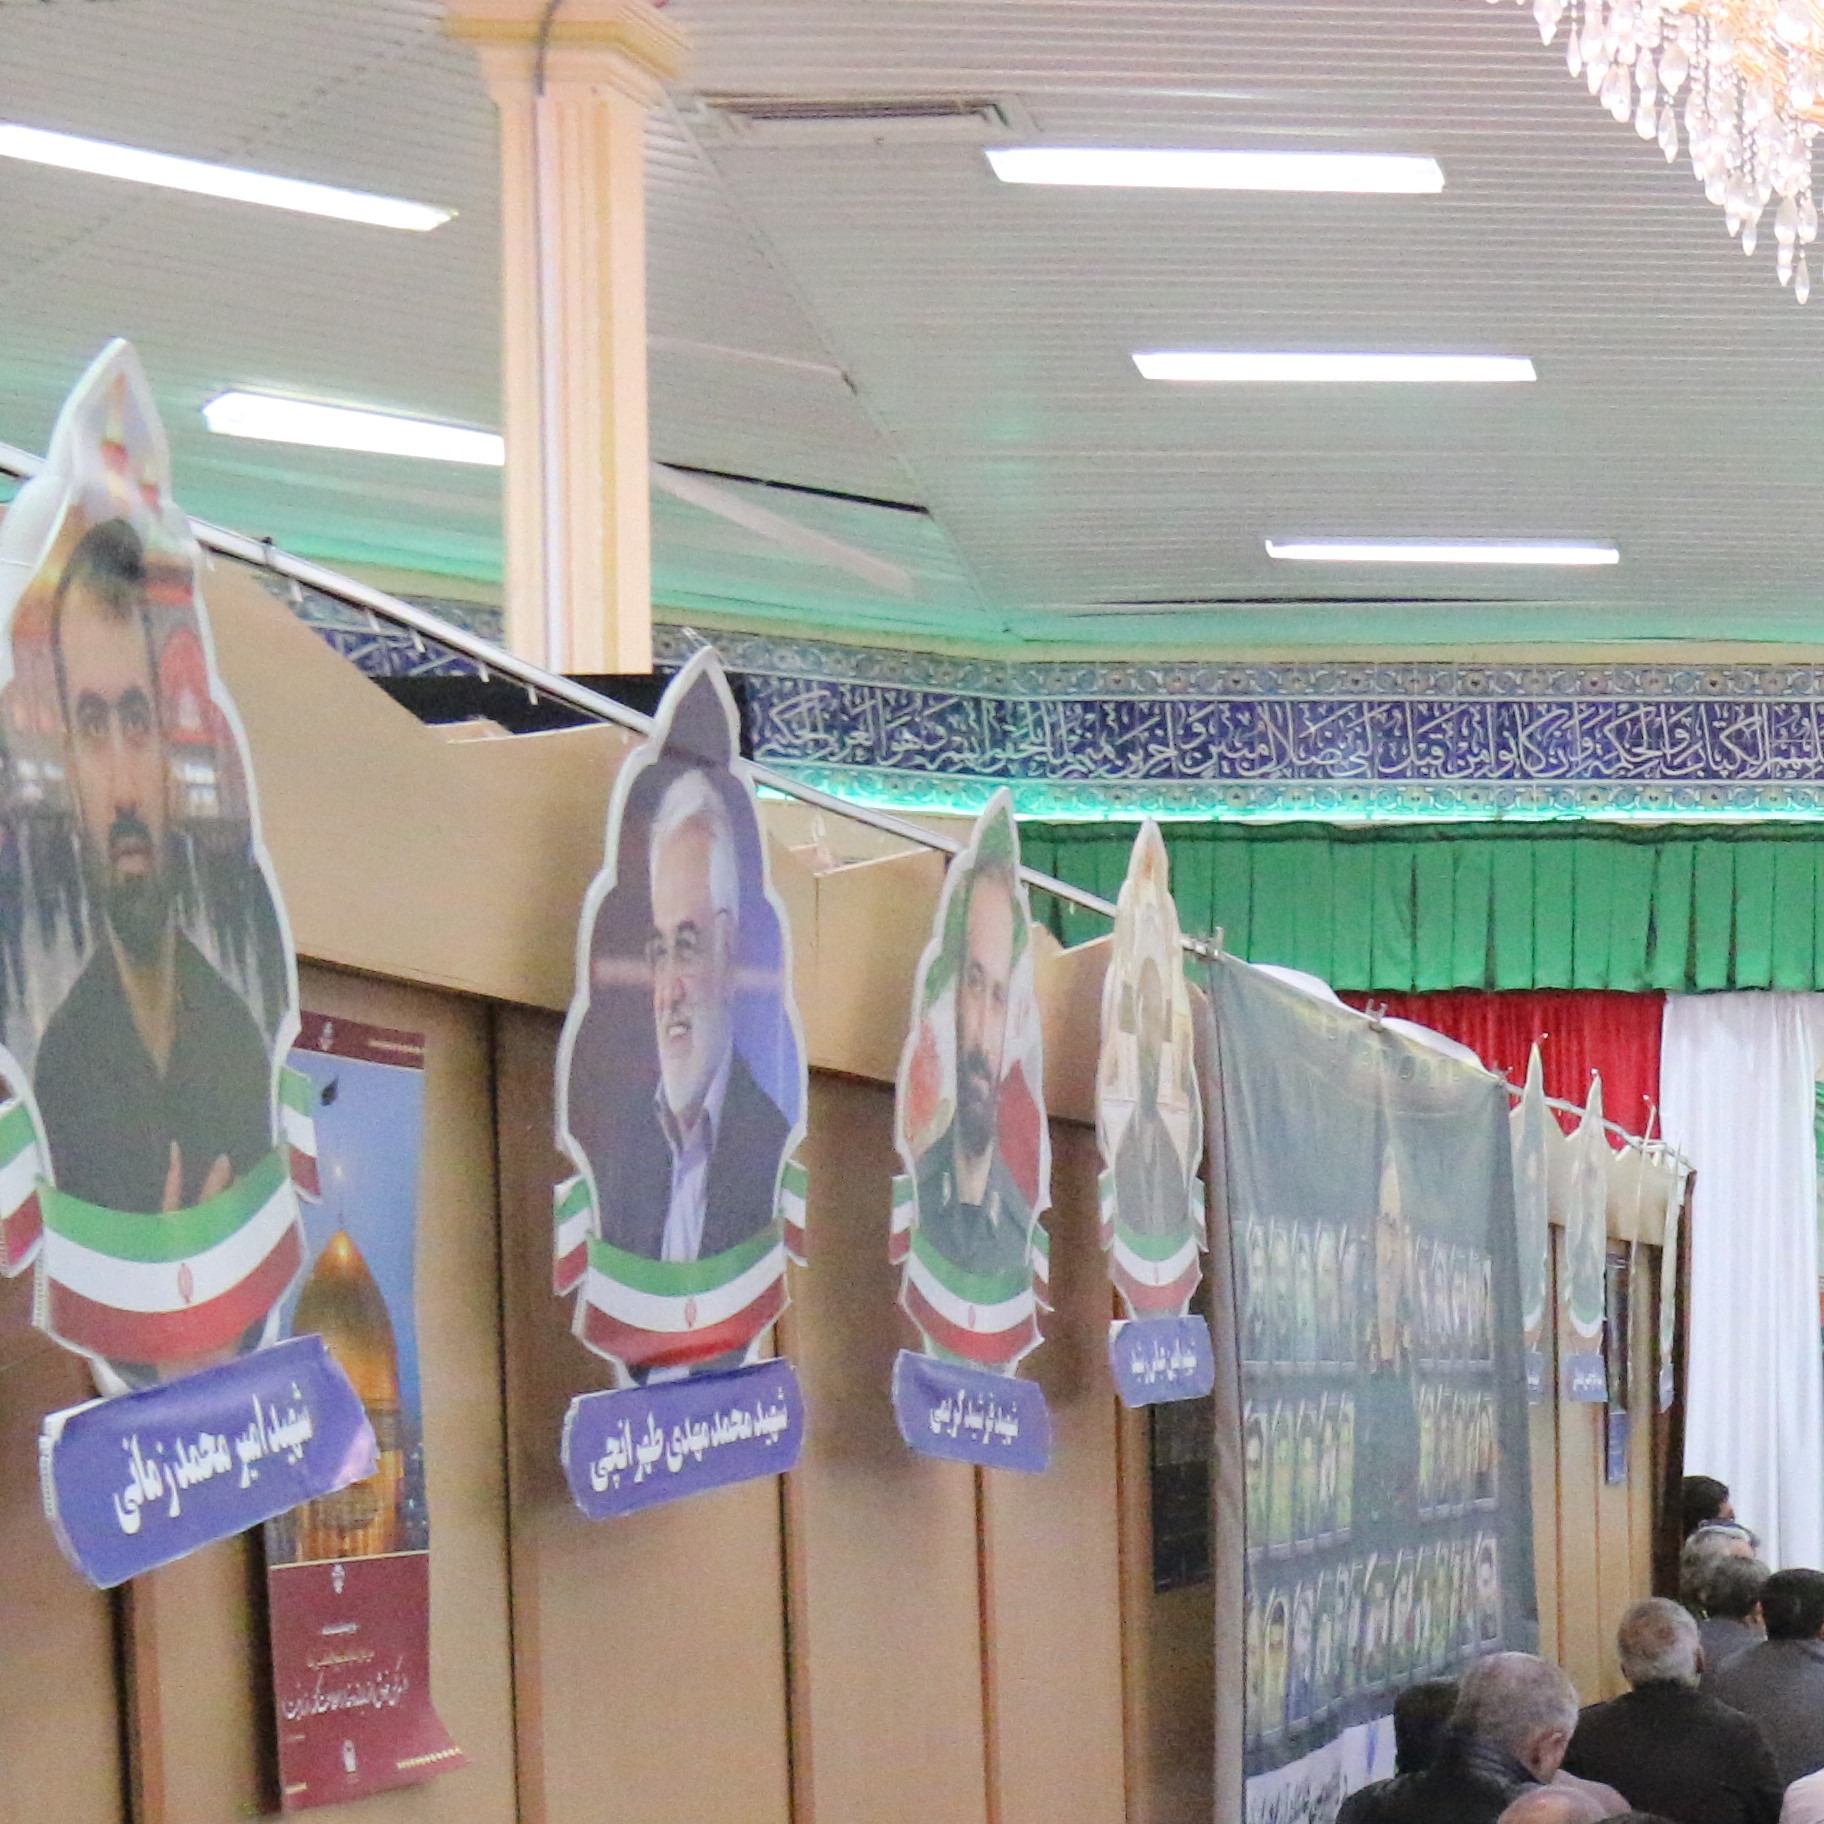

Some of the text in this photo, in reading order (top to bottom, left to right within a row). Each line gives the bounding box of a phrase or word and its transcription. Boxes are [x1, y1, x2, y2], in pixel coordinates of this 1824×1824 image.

[112, 1379, 313, 1536] شهید امیر محمد زمانی
[589, 1385, 789, 1493] شهید محمد مهدی طهرانچی
[993, 1400, 1020, 1446] شهید
